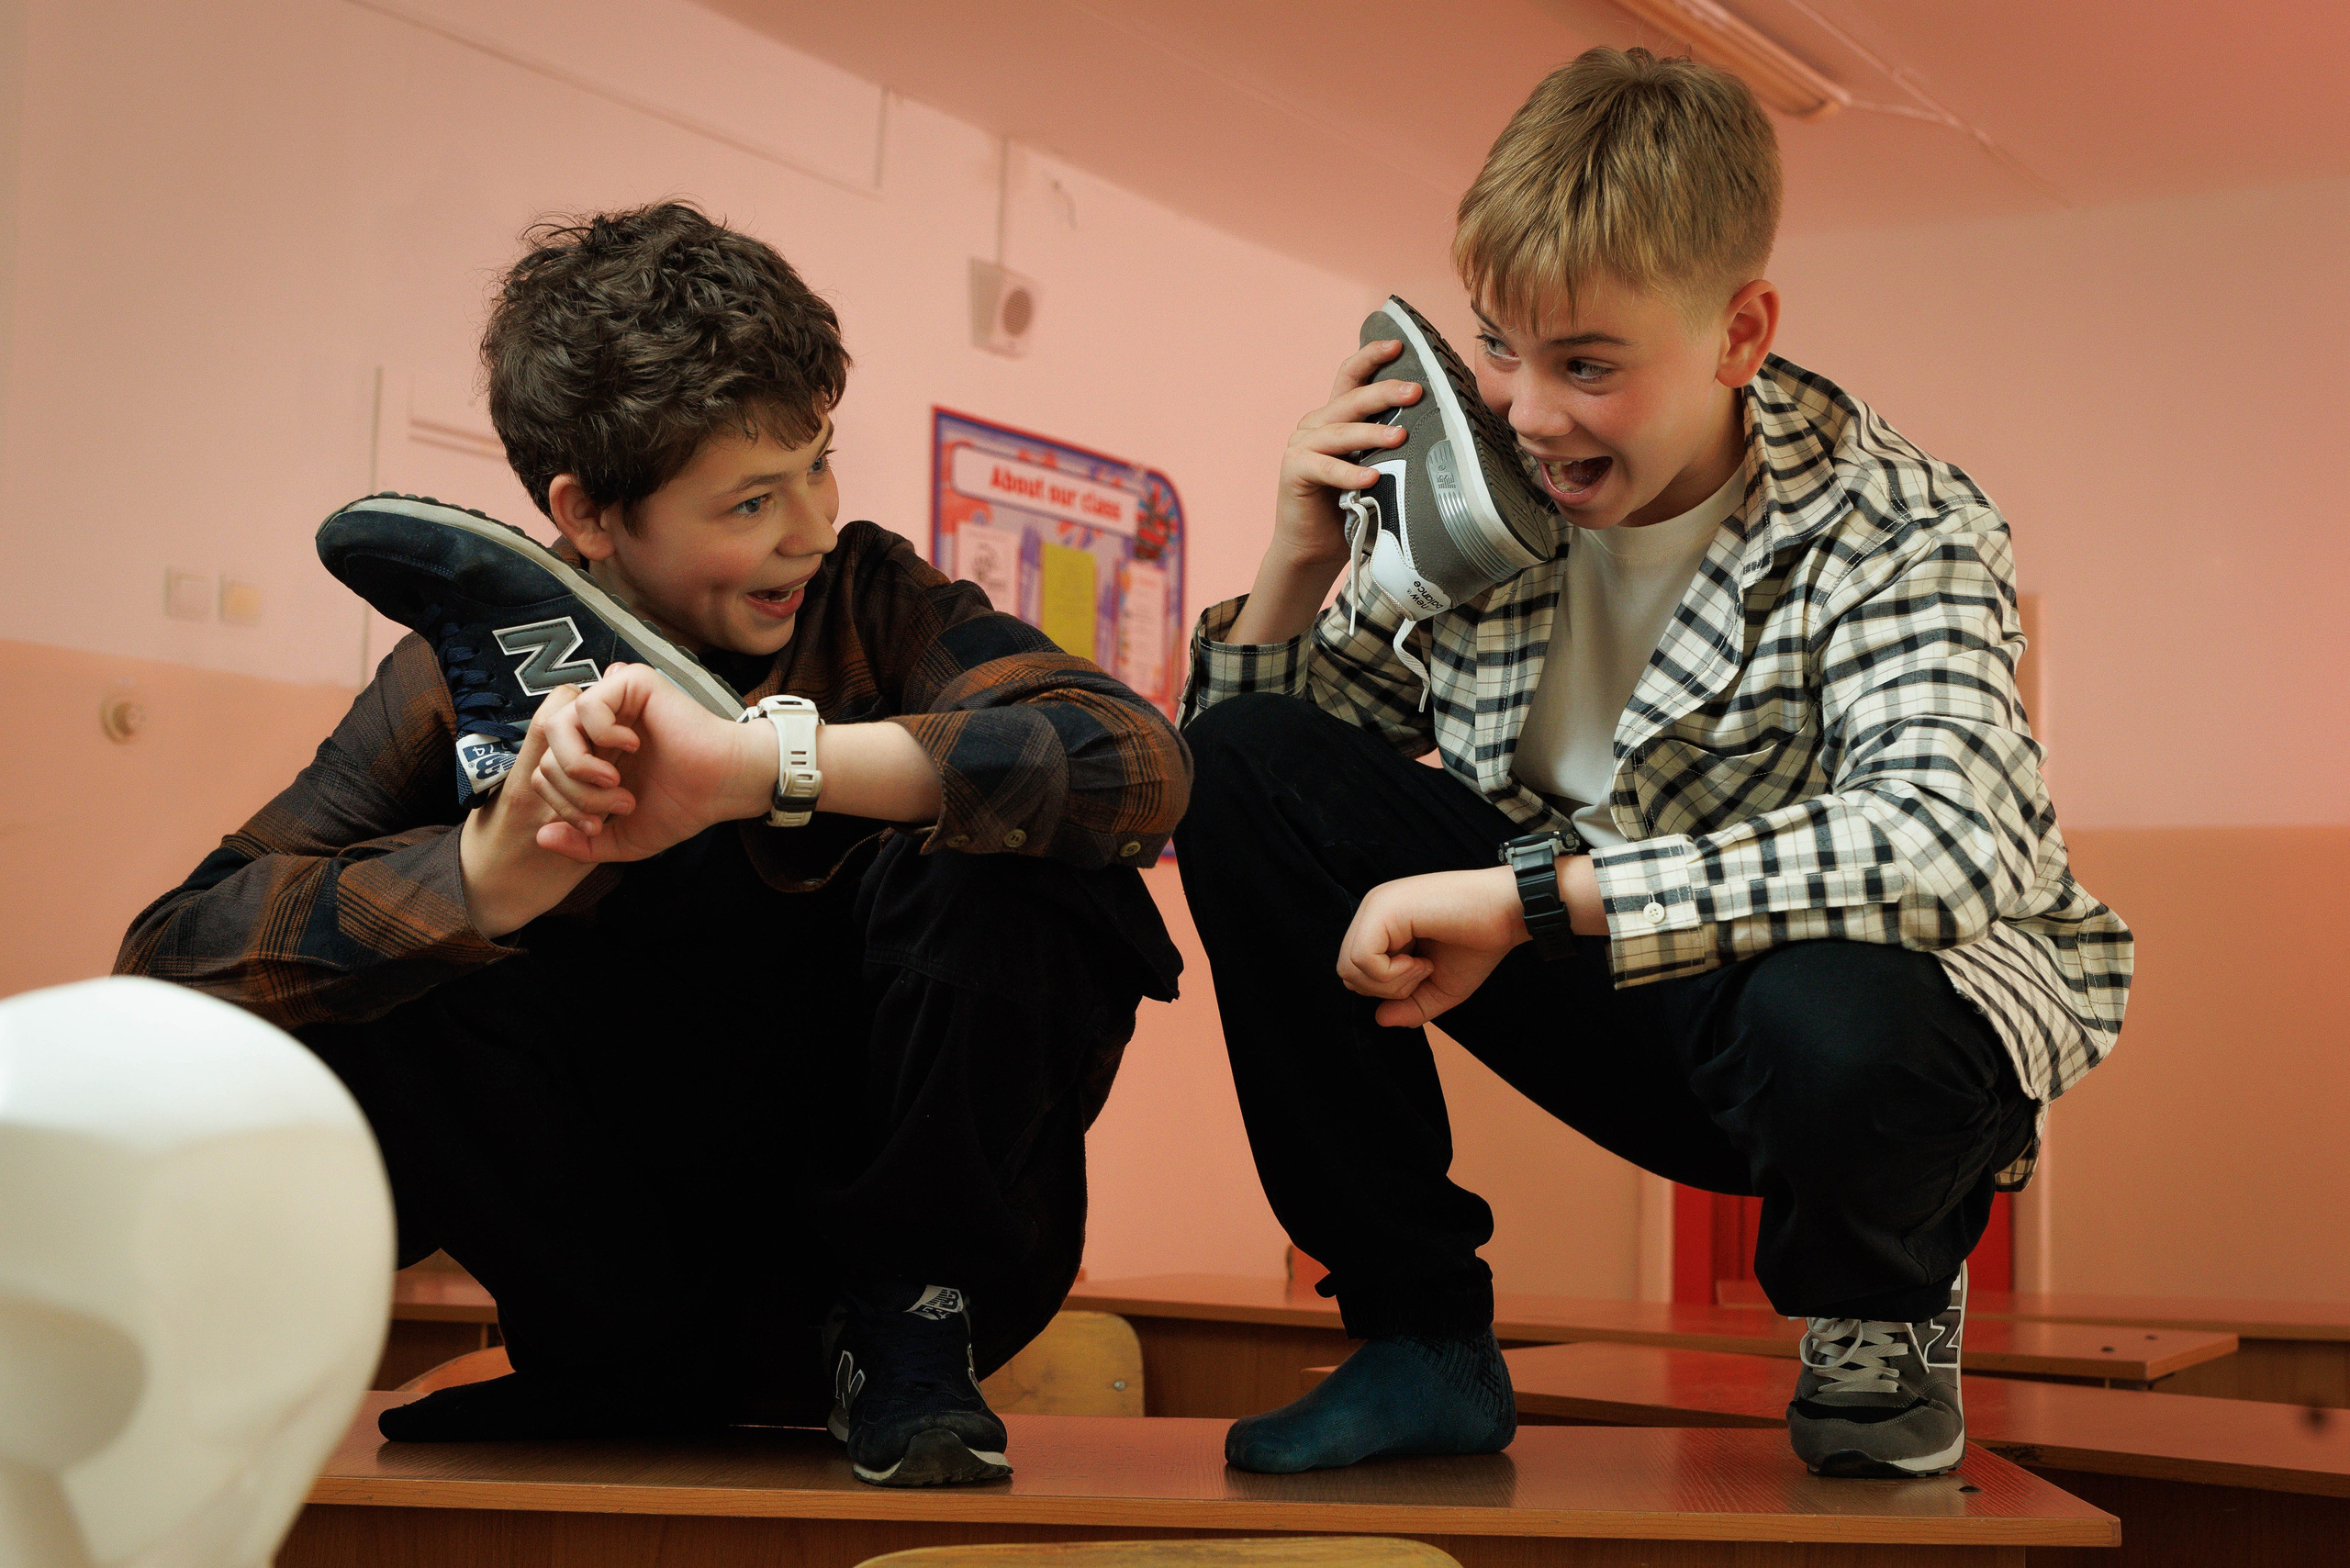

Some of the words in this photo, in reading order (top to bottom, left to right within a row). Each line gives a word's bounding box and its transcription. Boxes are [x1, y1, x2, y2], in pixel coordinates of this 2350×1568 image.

[991, 467, 1044, 498] About
[1049, 486, 1077, 506] our
[1081, 493, 1121, 521] class
[1410, 594, 1429, 609] new
[1414, 581, 1443, 609] balance
[492, 616, 601, 696] N
